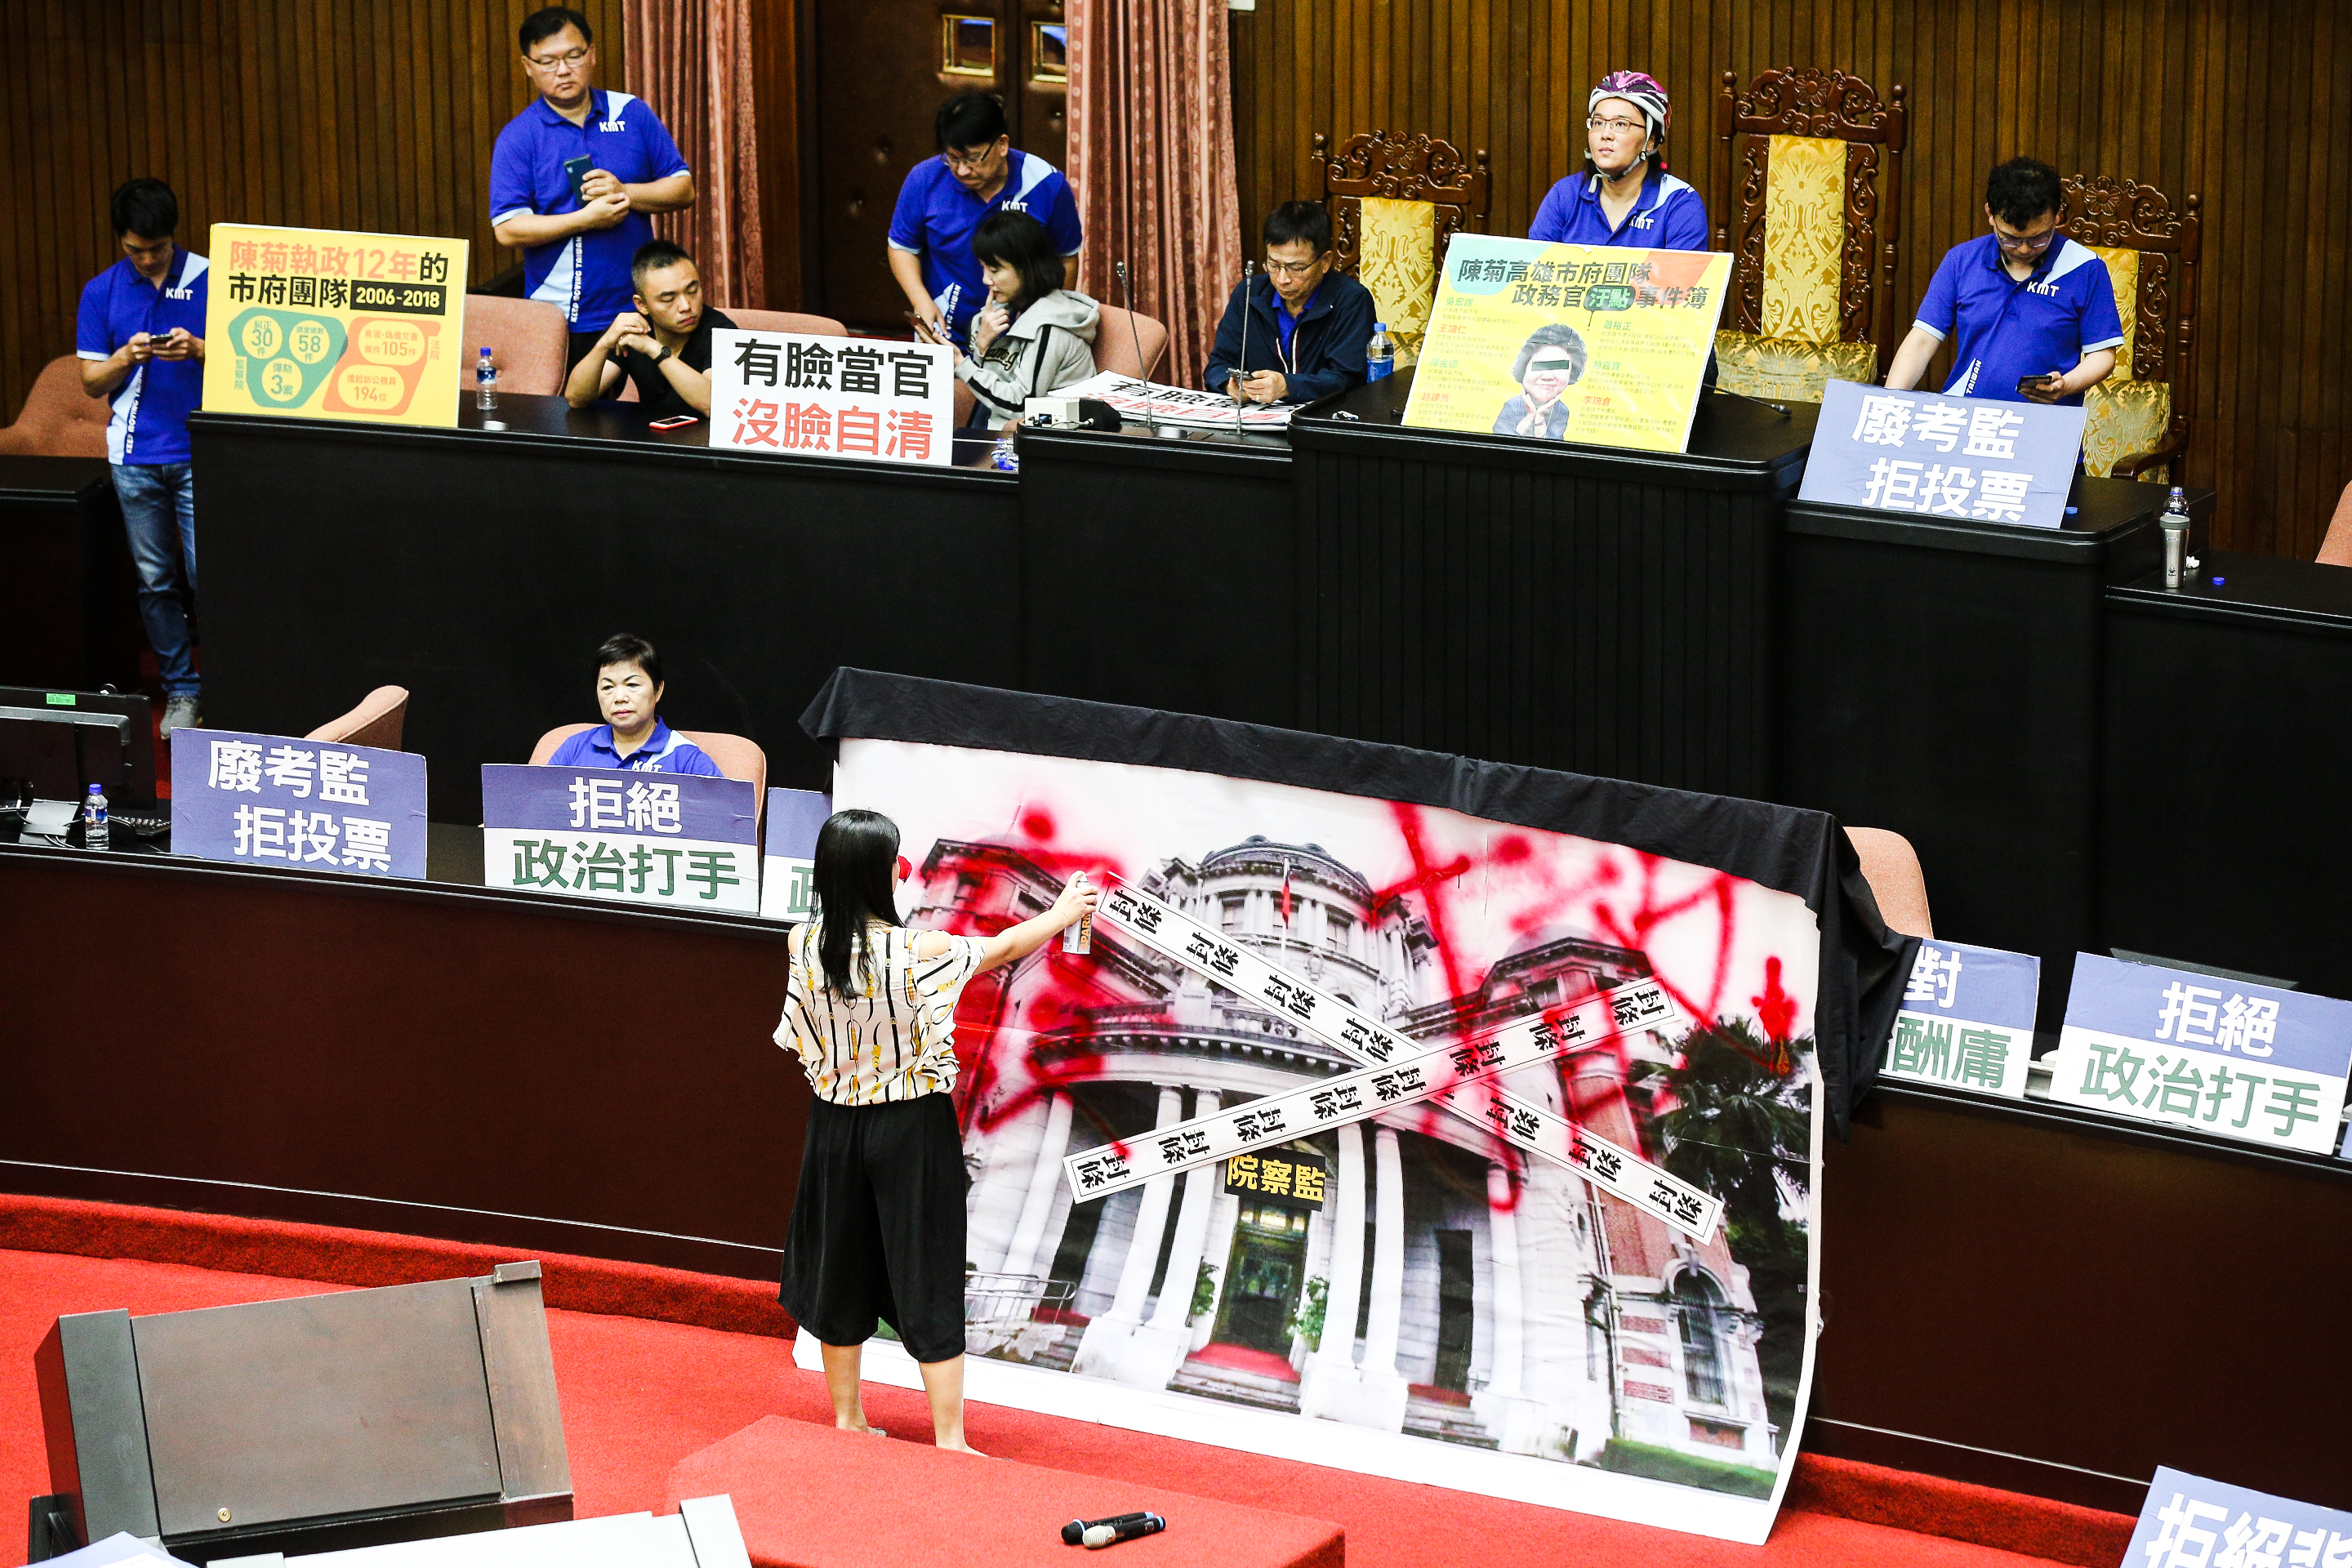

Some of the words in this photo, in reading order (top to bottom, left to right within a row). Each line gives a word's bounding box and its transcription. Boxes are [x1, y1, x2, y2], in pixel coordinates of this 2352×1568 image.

[599, 120, 626, 133] KMT
[1001, 200, 1028, 213] KMT
[229, 240, 448, 283] 陳菊執政12年的
[229, 273, 348, 308] 市府團隊
[356, 287, 441, 309] 2006-2018
[1458, 259, 1653, 285] 陳菊高雄市府團隊
[2026, 281, 2060, 297] KMT
[165, 287, 194, 301] KMT
[251, 329, 274, 347] 30
[298, 335, 321, 353] 58
[734, 338, 933, 399] 有臉當官
[1966, 359, 1982, 394] TAIWAN
[733, 398, 933, 459] 沒臉自清
[1851, 394, 2025, 461] 廢考監
[1861, 457, 2034, 523] 拒投票
[207, 739, 370, 808] 廢考監
[631, 760, 663, 773] KMT
[568, 775, 683, 834] 拒絕
[233, 804, 392, 874] 拒投票
[512, 838, 741, 901] 政治打手
[1904, 946, 1962, 1009] 對
[2154, 981, 2280, 1058] 拒絕
[1881, 1015, 2011, 1089] 酬庸
[2079, 1043, 2321, 1137] 政治打手
